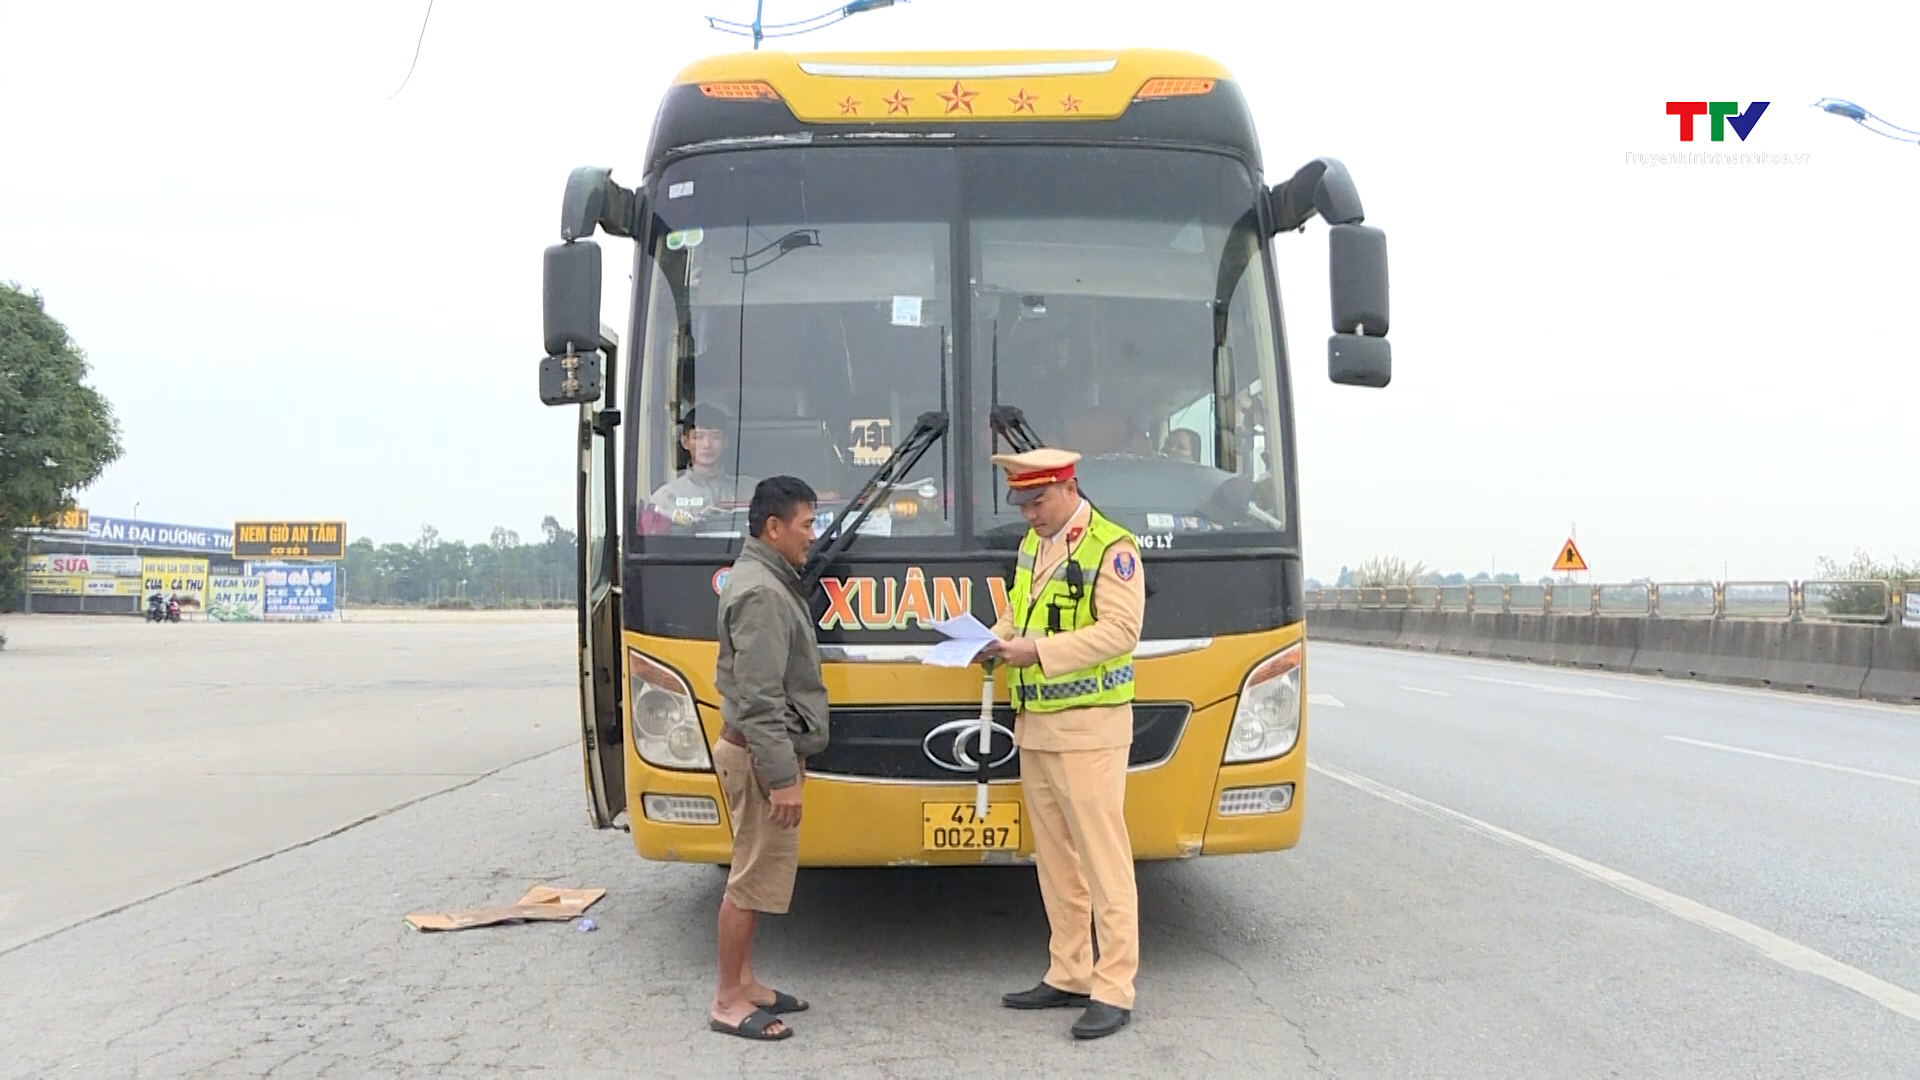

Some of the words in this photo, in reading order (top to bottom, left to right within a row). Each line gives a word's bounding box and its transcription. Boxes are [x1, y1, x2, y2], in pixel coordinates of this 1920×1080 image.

[128, 525, 156, 546] ĐẠI
[158, 528, 206, 547] DƯƠNG
[240, 525, 267, 542] NEM
[292, 525, 309, 542] AN
[311, 522, 337, 542] TÂM
[1136, 535, 1154, 548] NG
[1156, 531, 1174, 548] LÝ
[145, 578, 163, 590] CUA
[185, 579, 204, 591] THU
[213, 579, 238, 588] NEM
[242, 579, 260, 588] VIP
[215, 593, 231, 602] AN
[818, 566, 974, 630] XUÂN
[951, 805, 992, 824] 47
[934, 827, 1009, 848] 002.87
